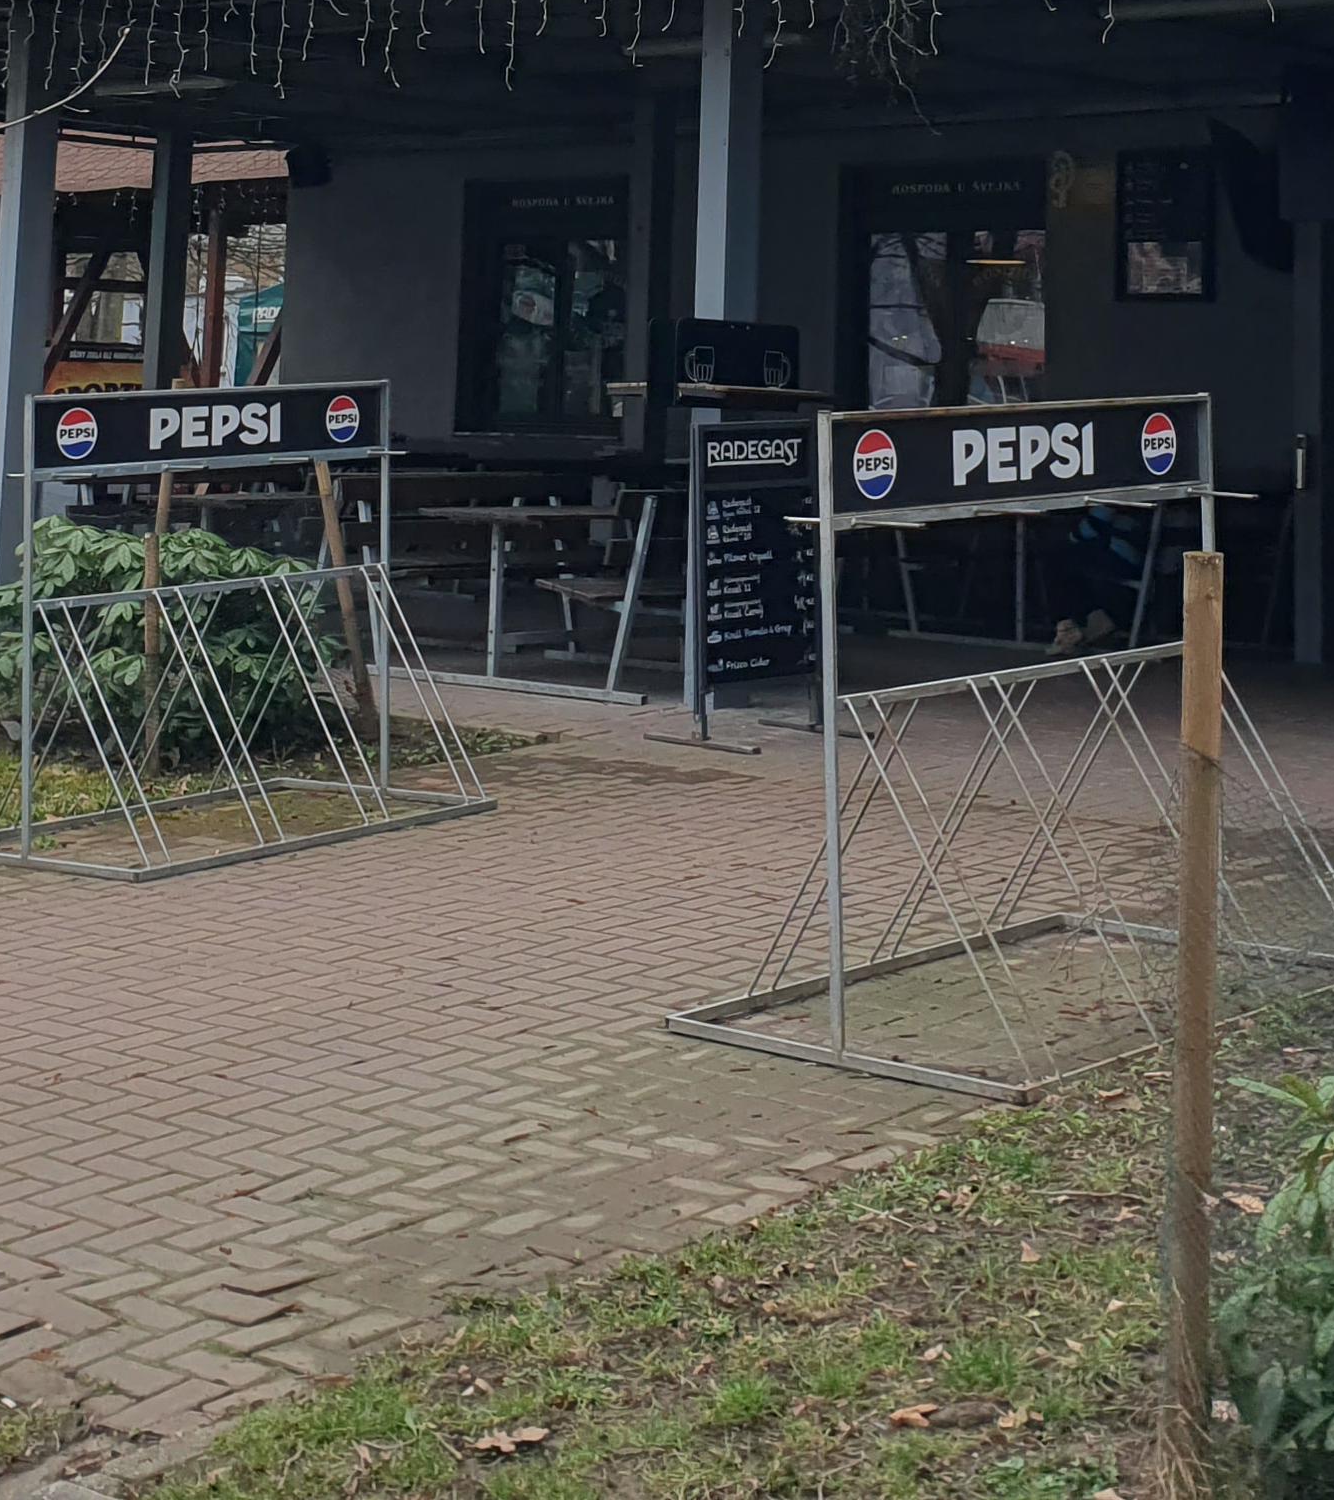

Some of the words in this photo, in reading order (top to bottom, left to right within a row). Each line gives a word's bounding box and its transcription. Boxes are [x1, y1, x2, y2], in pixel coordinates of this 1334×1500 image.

[59, 426, 95, 439] PEPSI
[149, 402, 281, 450] PEPSI
[328, 413, 358, 425] PEPSI
[707, 438, 803, 467] RADEGAST
[856, 455, 894, 472] PEPSI
[952, 420, 1095, 487] PEPSI
[1143, 436, 1174, 451] PEPSI
